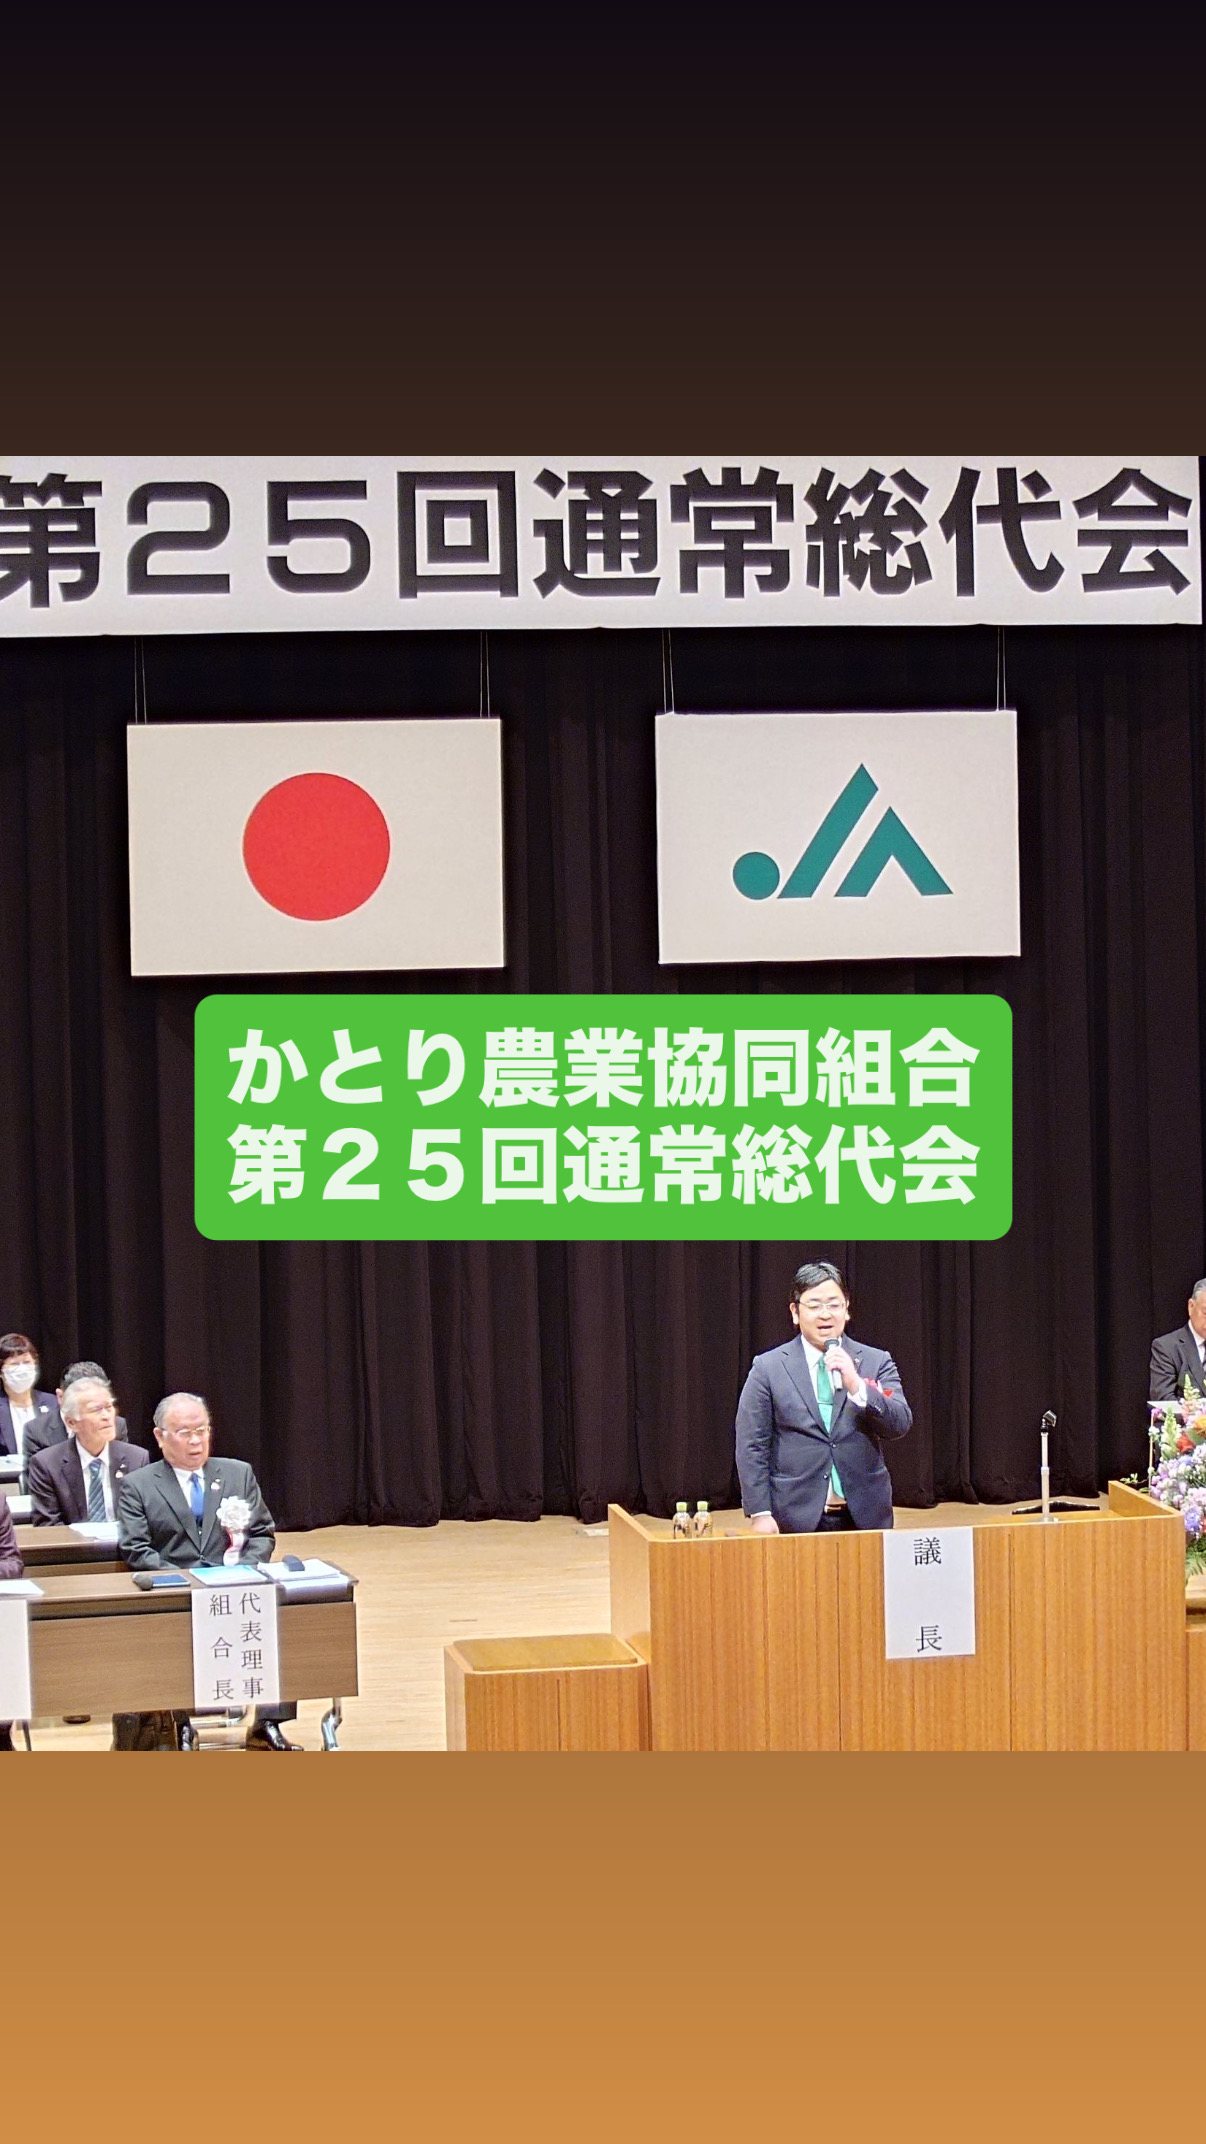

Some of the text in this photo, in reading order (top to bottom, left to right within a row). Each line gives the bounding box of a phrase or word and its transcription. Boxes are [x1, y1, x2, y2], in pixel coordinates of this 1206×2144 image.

[0, 466, 1194, 609] 第25回通常総代会
[209, 1594, 234, 1700] 組合長
[239, 1592, 264, 1699] 代表理事
